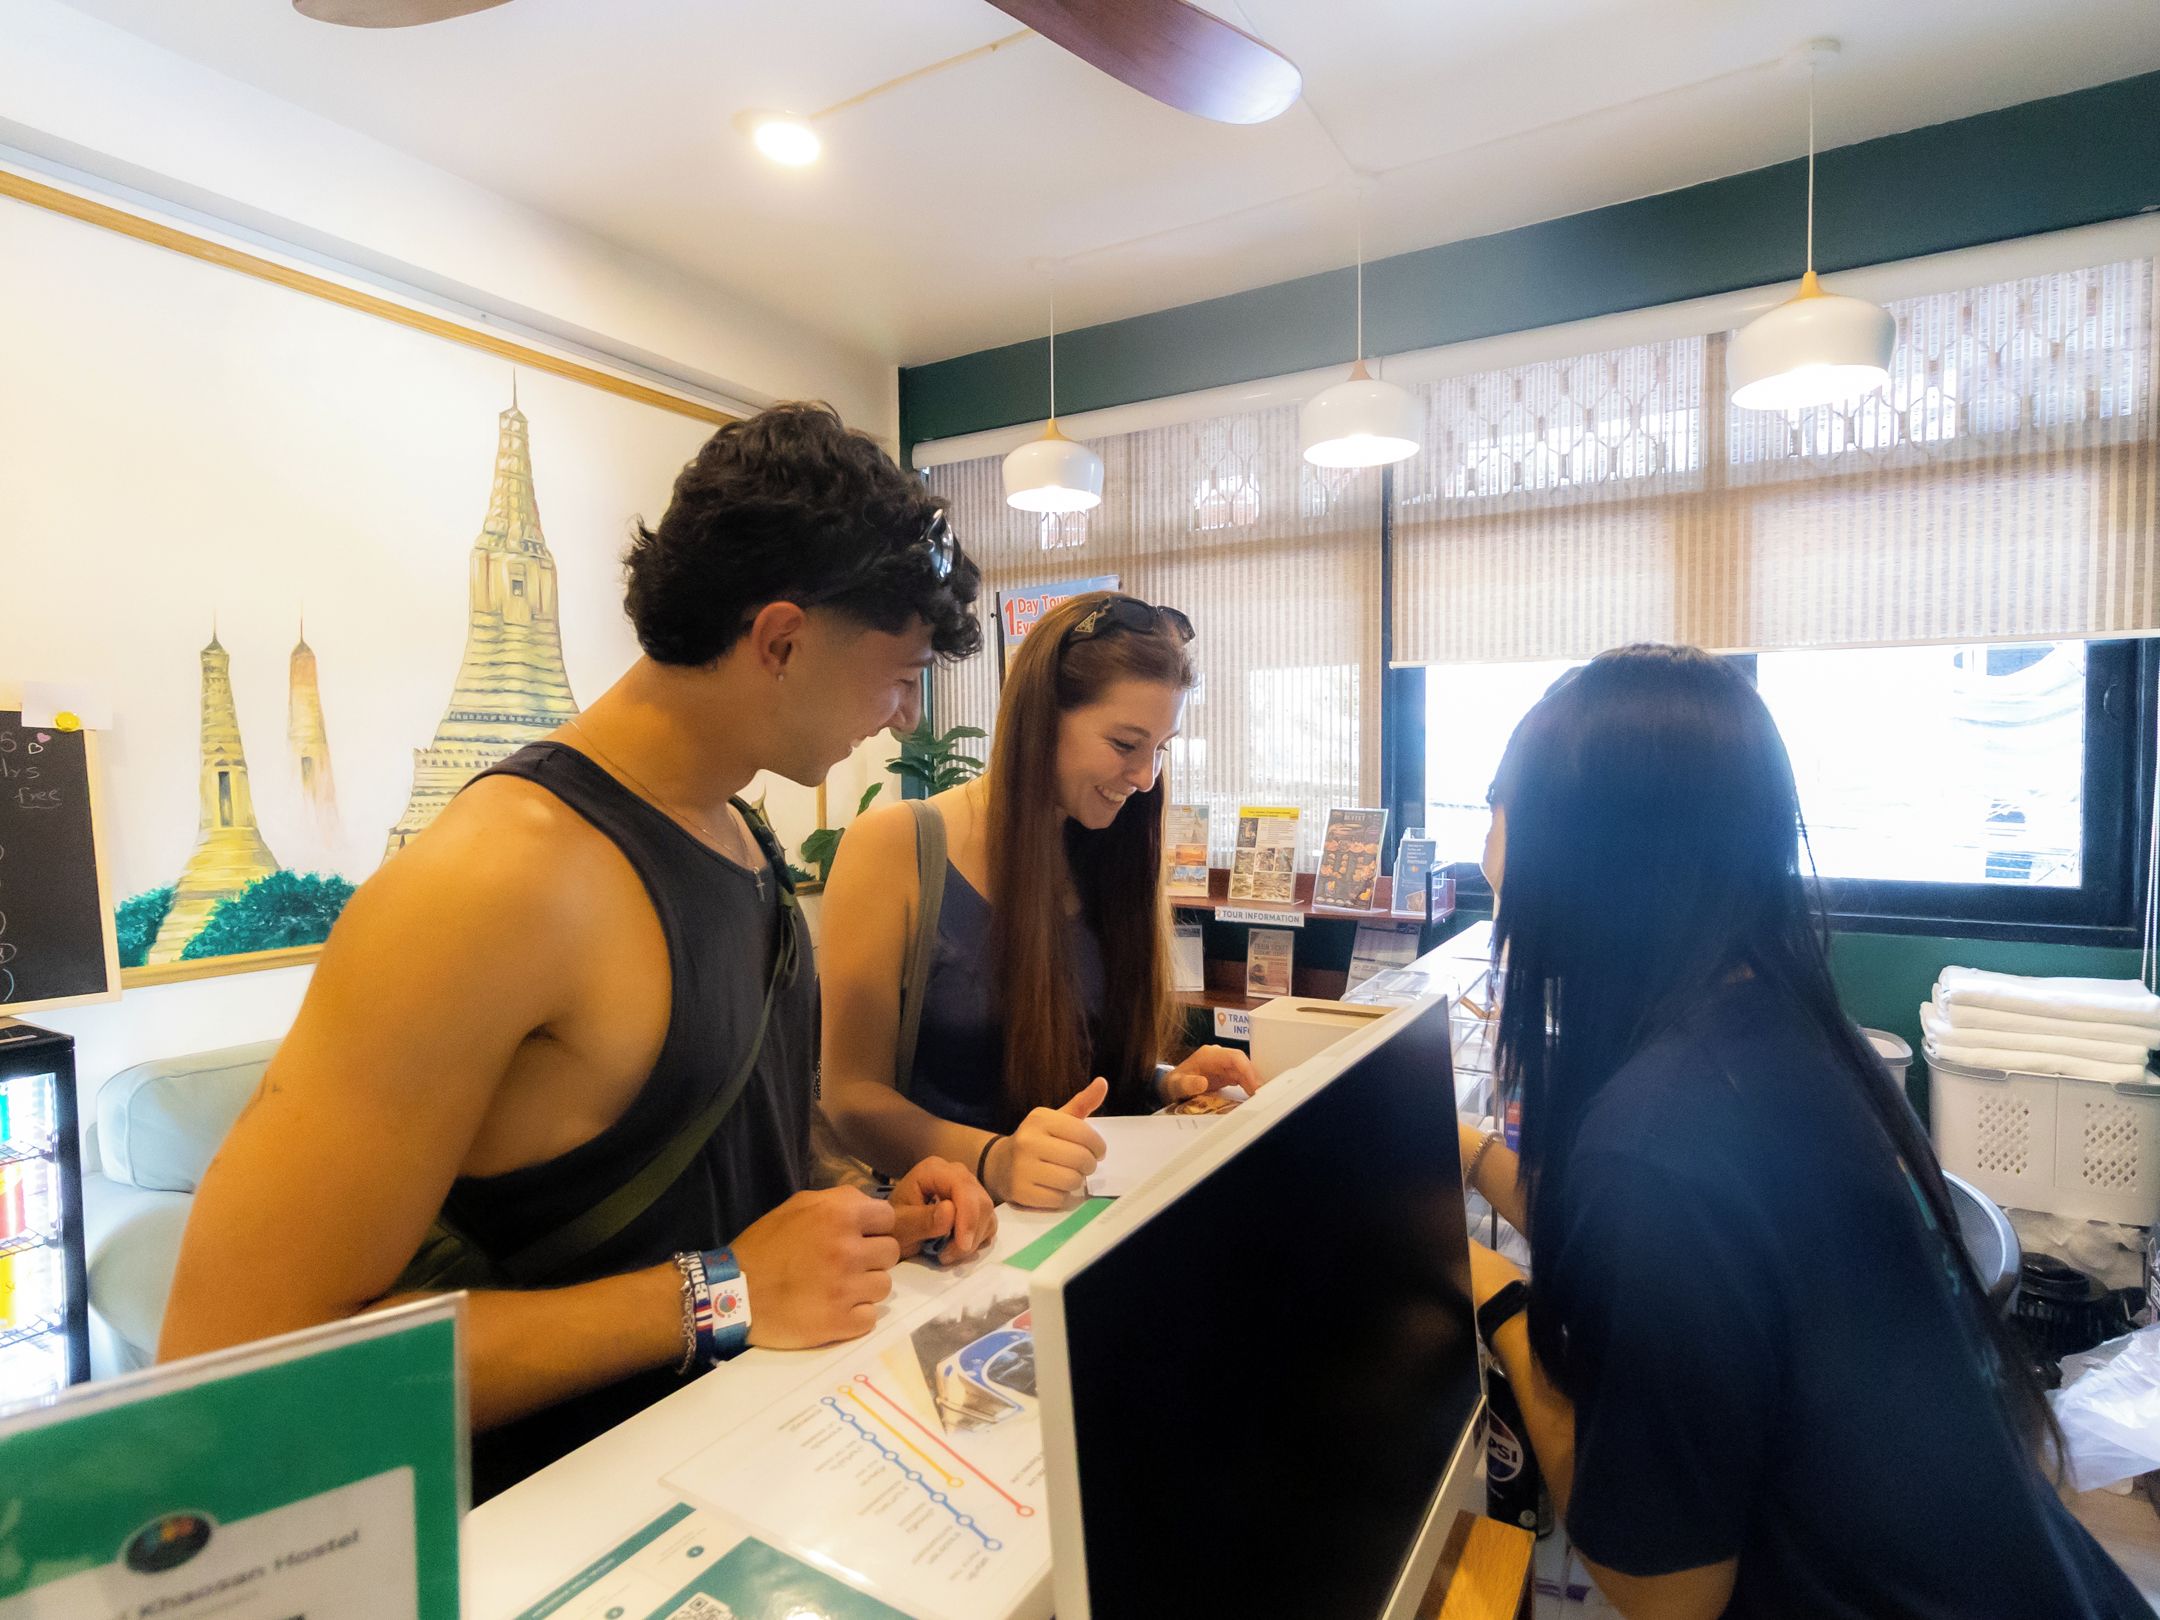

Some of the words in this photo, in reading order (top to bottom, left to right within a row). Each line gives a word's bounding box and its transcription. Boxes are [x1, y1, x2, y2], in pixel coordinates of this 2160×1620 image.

[1016, 598, 1039, 616] Day
[1223, 910, 1243, 919] TOUR
[1245, 911, 1299, 922] INFORMATION
[272, 1528, 360, 1572] Hostel
